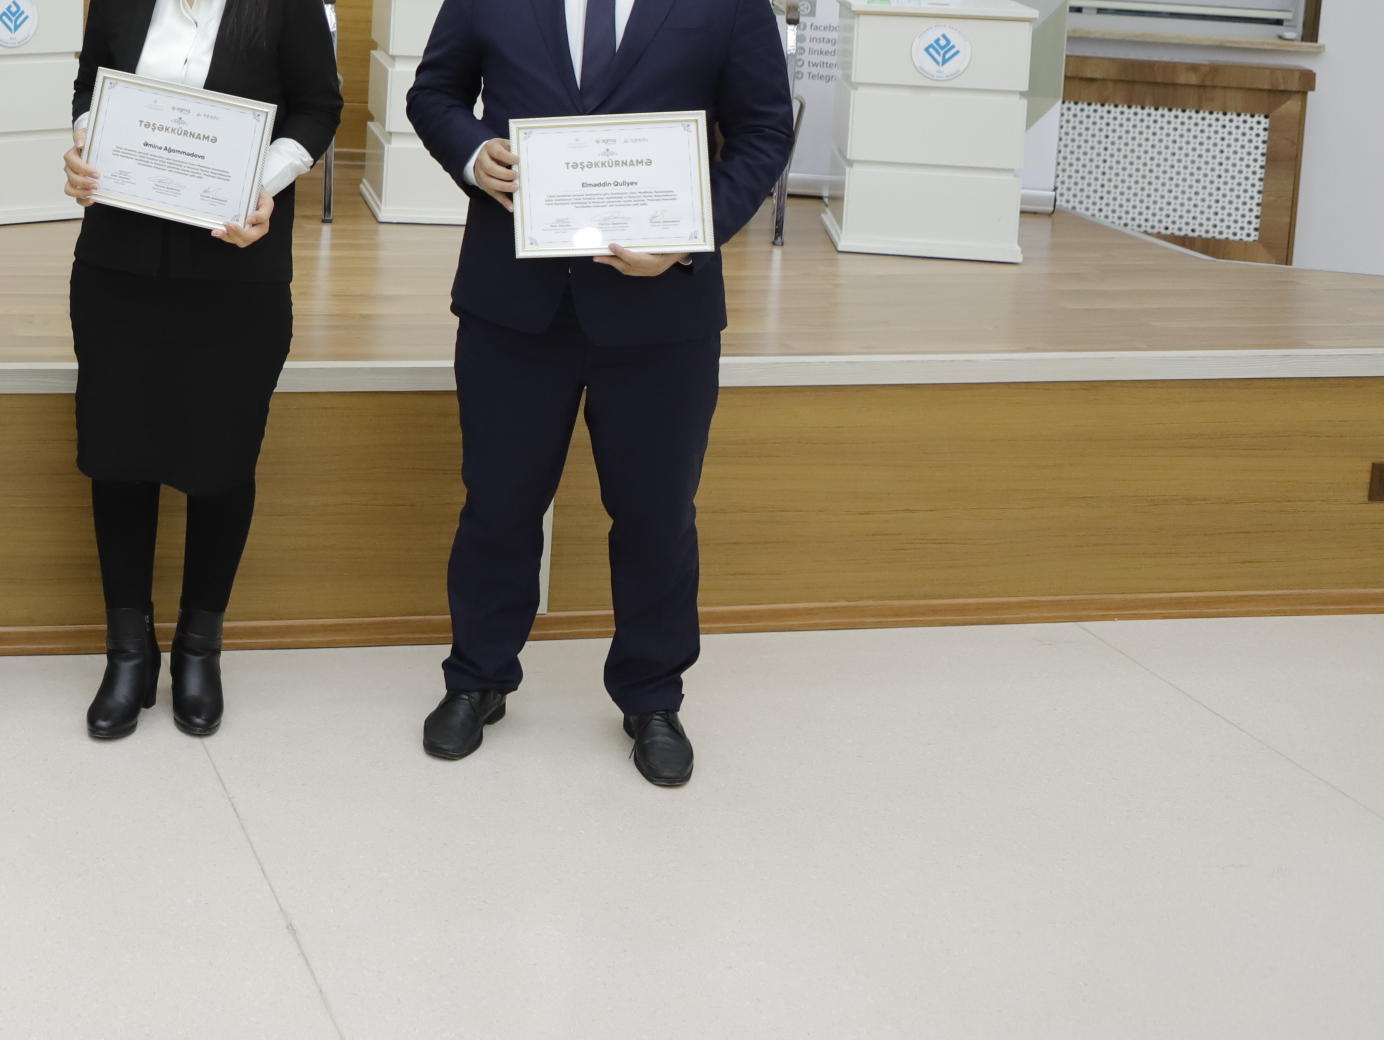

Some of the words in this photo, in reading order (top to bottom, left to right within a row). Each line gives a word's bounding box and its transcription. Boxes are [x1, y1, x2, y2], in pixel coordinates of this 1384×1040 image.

[810, 22, 839, 32] facebo
[809, 35, 837, 46] instag
[808, 47, 837, 56] linked
[808, 60, 838, 69] twitter
[139, 120, 218, 144] TƏŞƏKKÜRNAMƏ
[565, 158, 653, 171] TƏŞƏKKÜRNAMƏ
